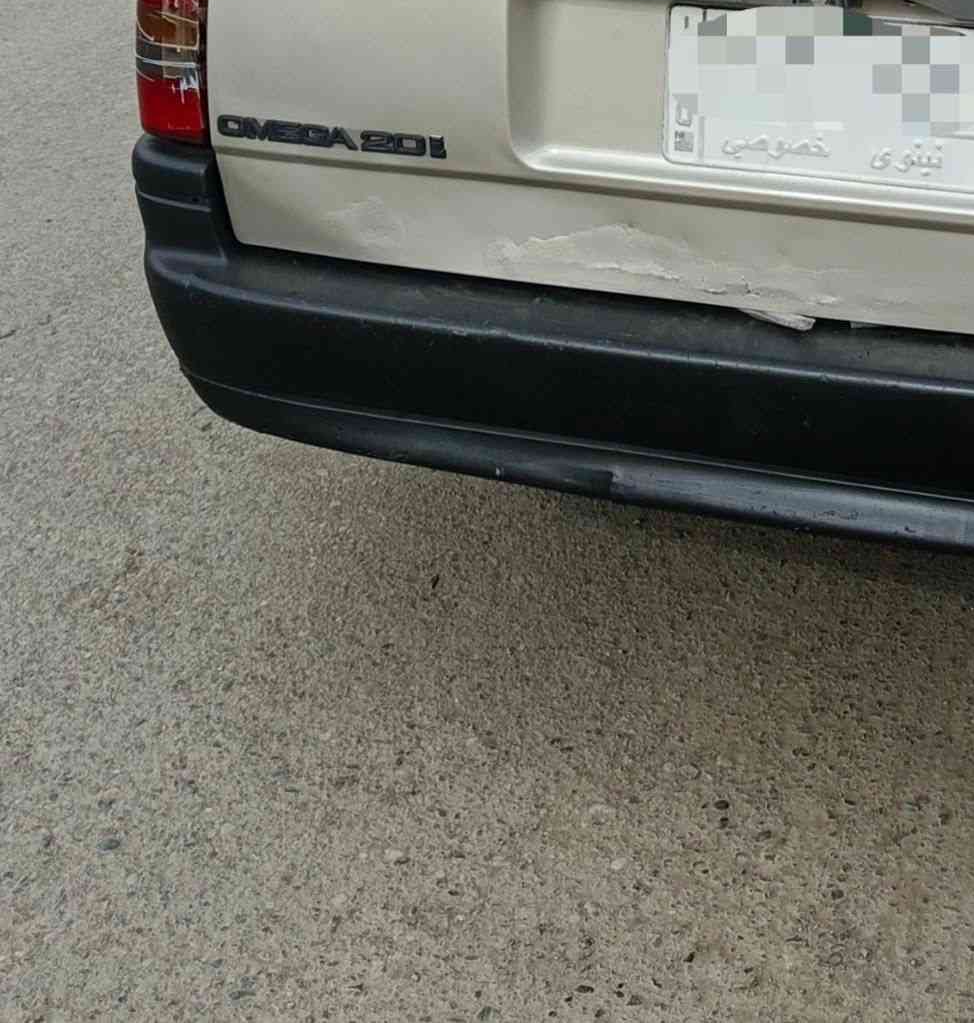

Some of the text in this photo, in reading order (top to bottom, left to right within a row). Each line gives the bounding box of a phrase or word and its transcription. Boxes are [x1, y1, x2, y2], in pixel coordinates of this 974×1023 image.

[217, 114, 358, 151] OMEGA
[722, 135, 943, 176] نينوى خصوصي
